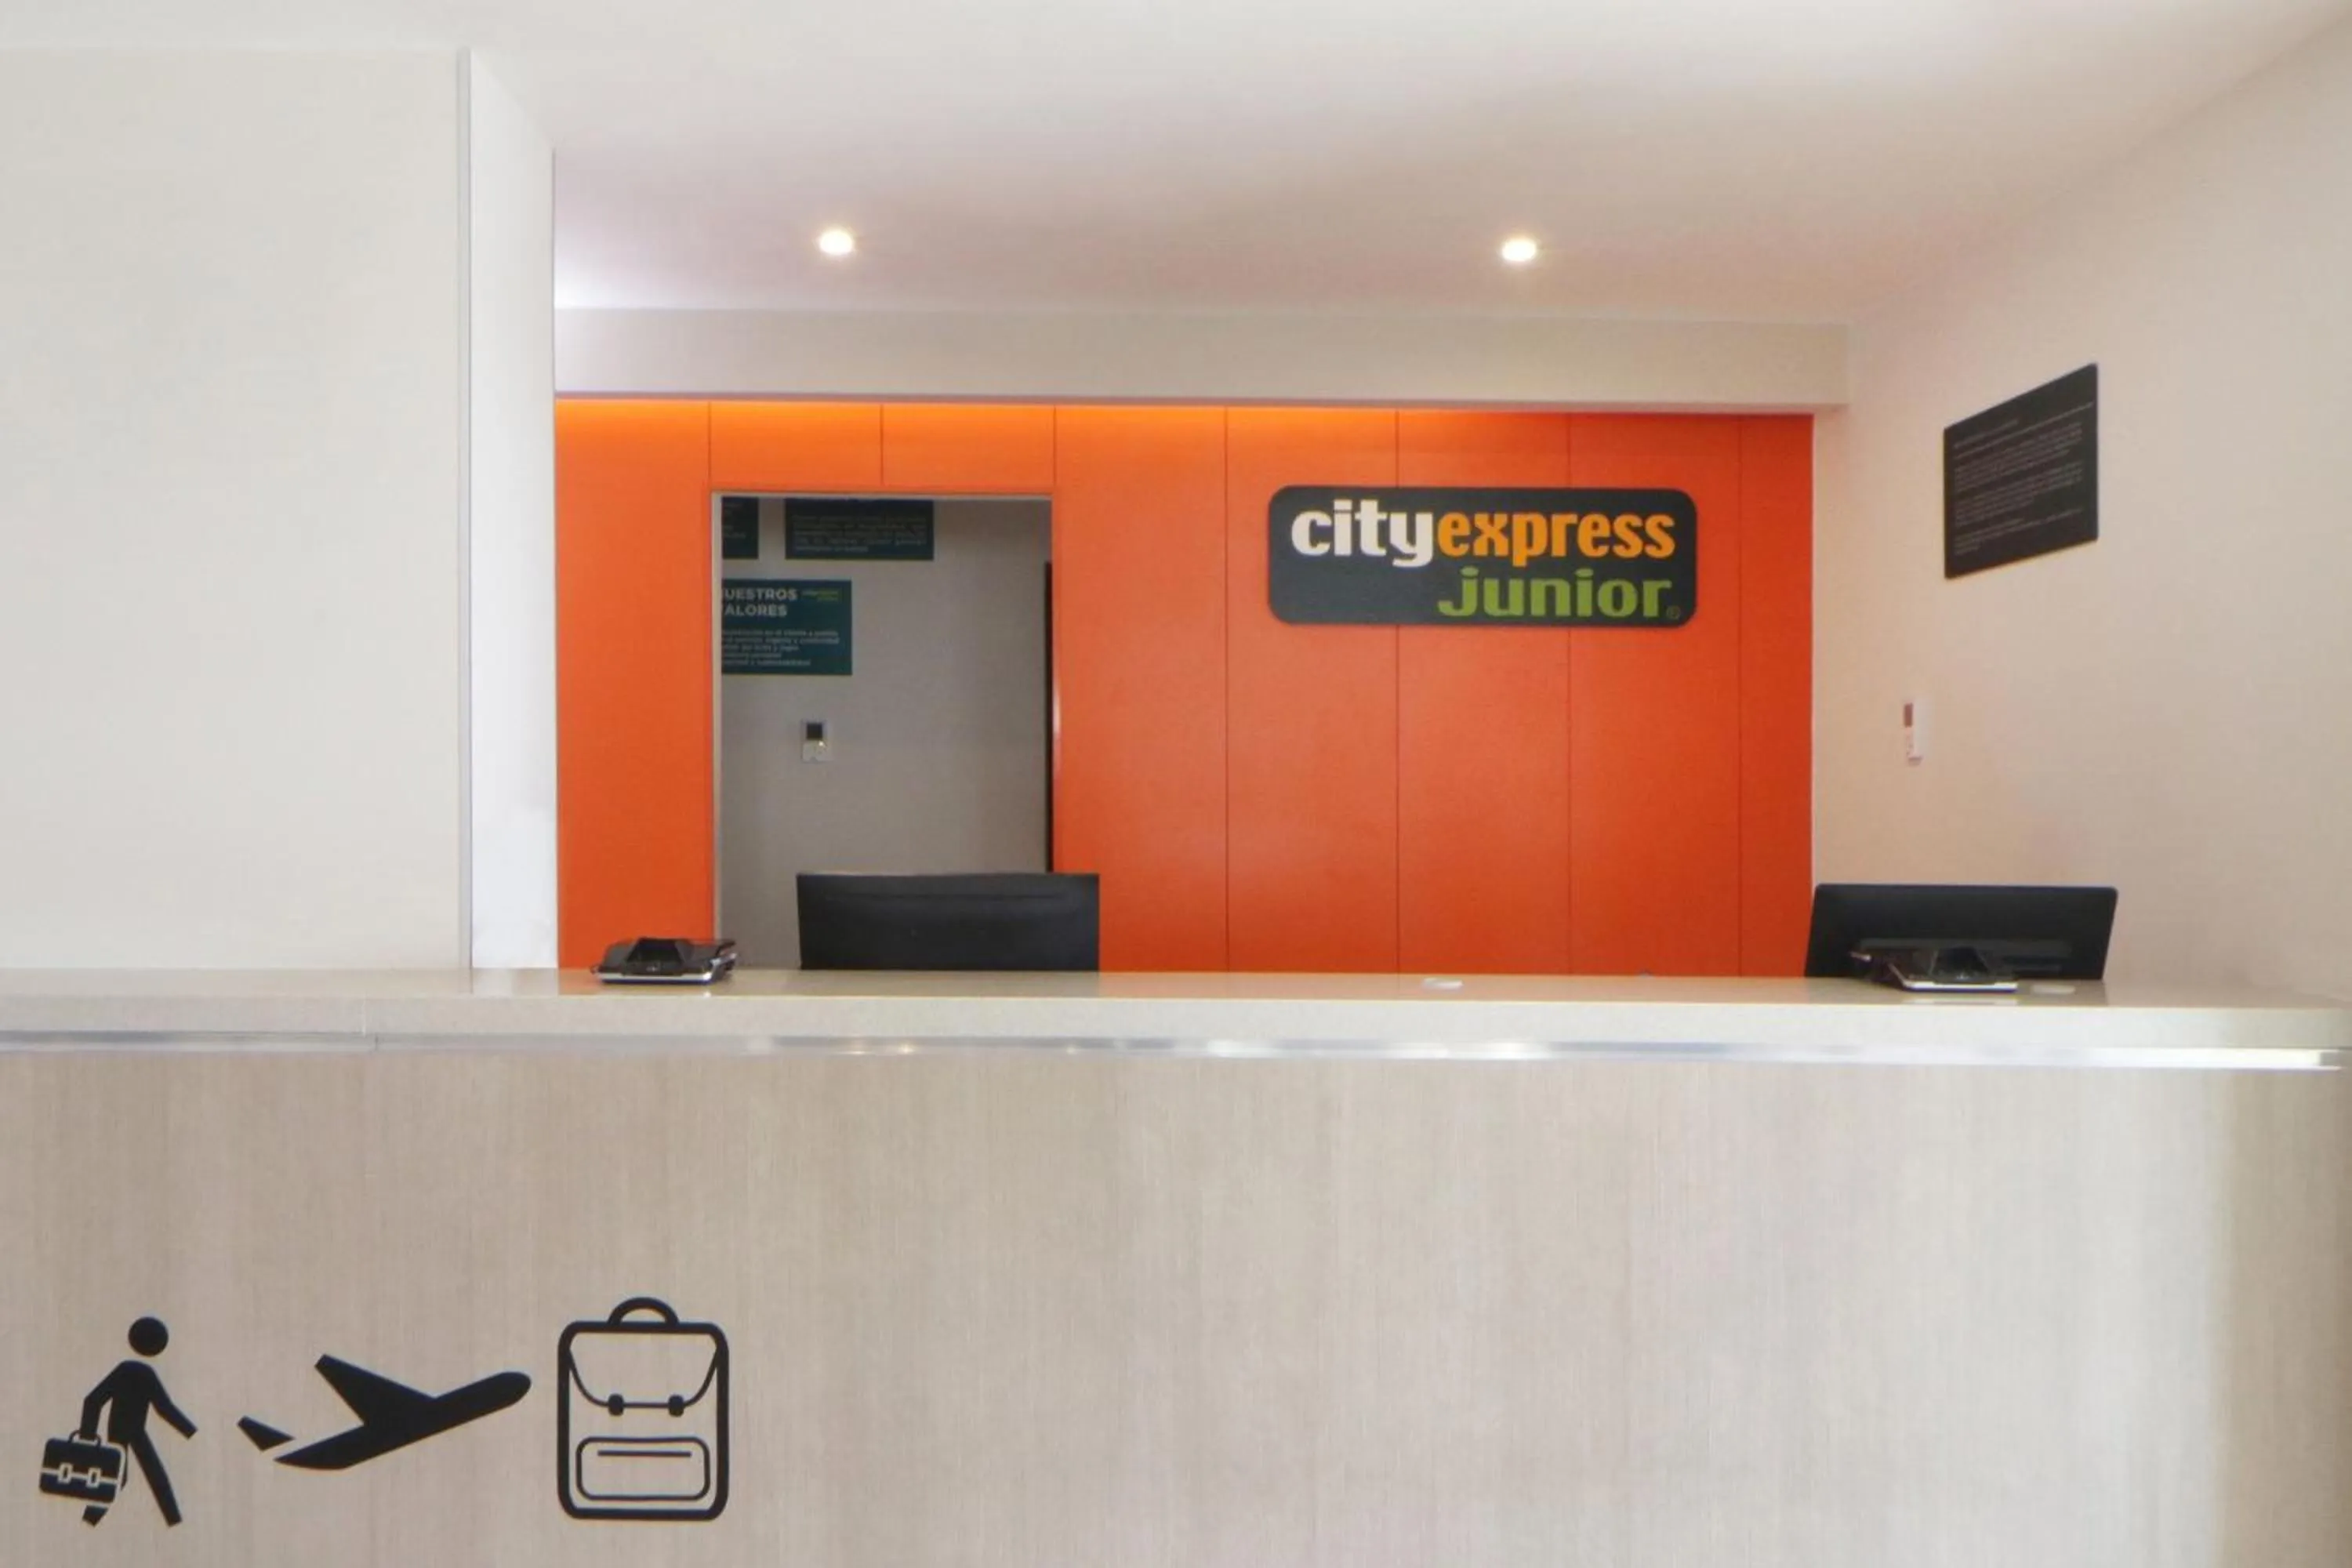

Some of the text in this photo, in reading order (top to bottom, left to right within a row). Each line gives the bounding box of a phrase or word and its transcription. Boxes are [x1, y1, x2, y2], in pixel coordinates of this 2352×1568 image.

[724, 587, 798, 601] UESTROS
[1436, 566, 1671, 618] junior
[724, 603, 788, 617] ALORES
